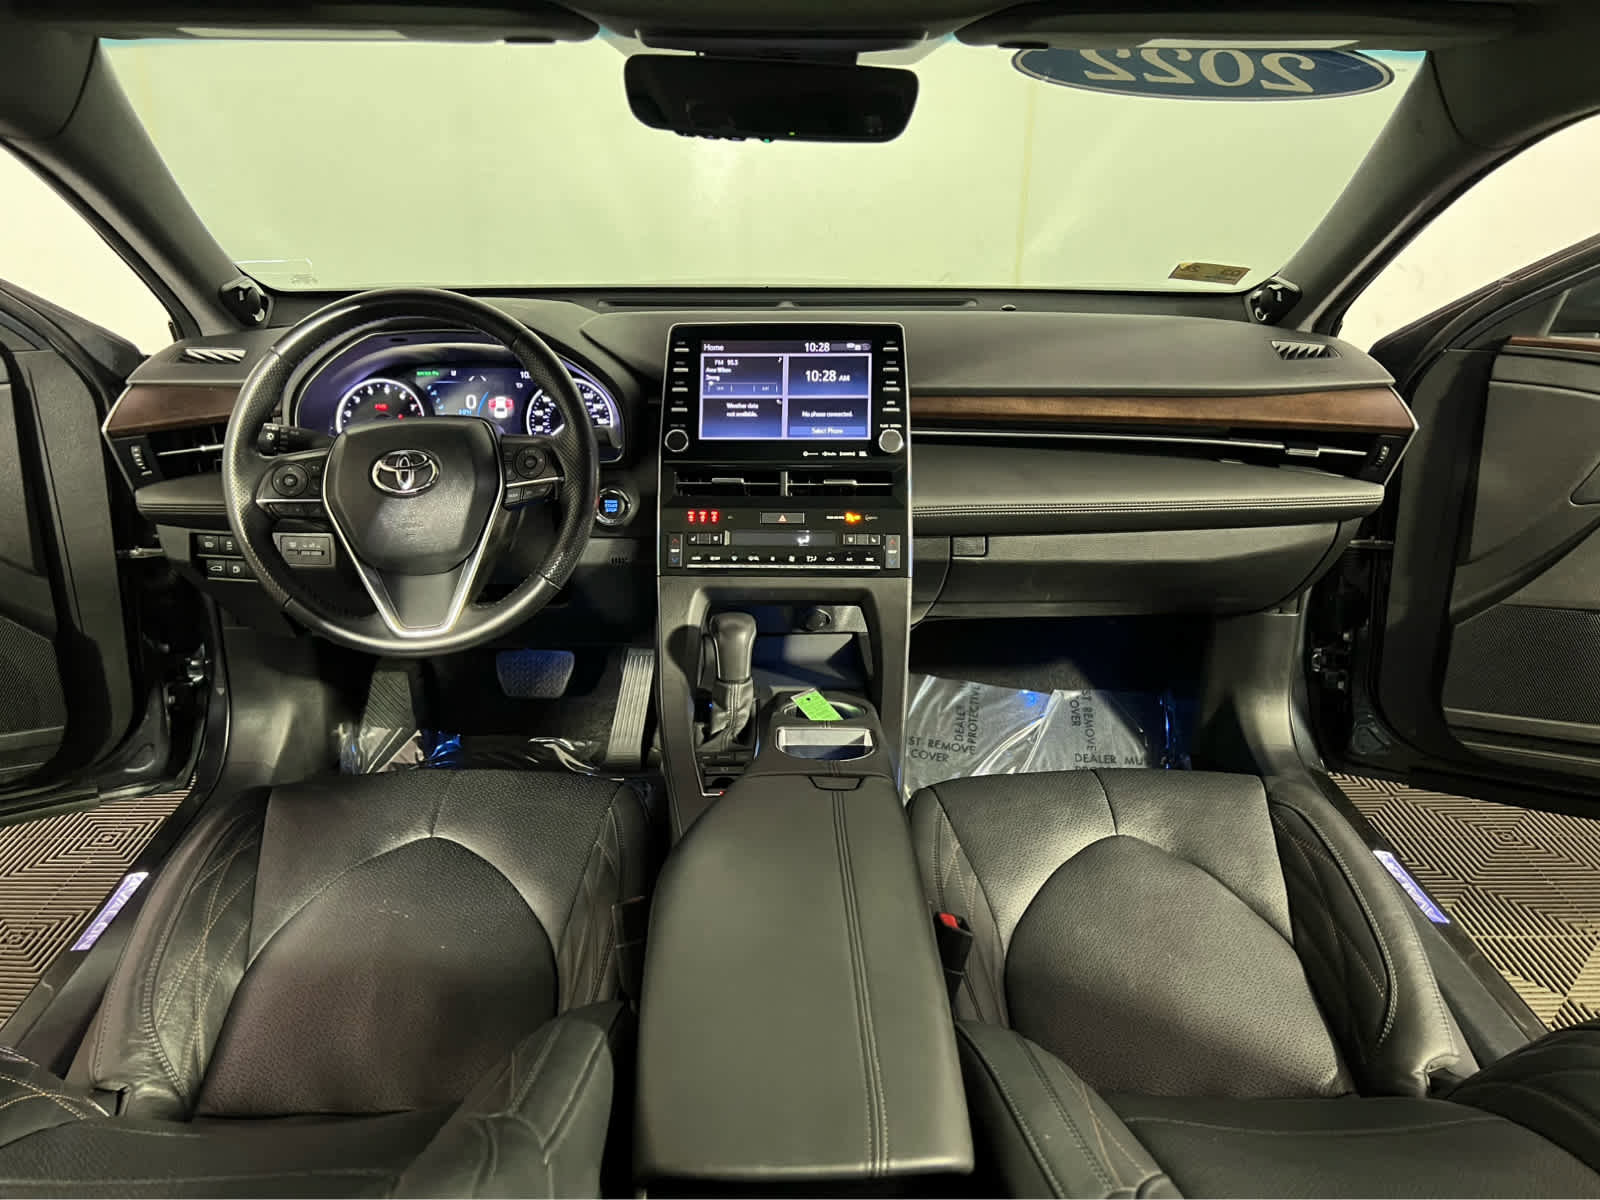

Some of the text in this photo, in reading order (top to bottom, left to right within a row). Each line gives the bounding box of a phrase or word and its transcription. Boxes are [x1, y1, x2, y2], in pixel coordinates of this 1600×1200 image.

[703, 343, 725, 351] Home
[804, 342, 831, 353] 10:28
[805, 370, 837, 382] 10:28
[465, 394, 477, 409] 0
[1069, 697, 1082, 727] OVER
[1083, 706, 1097, 751] REMOVE
[910, 748, 949, 762] COVER
[1074, 752, 1117, 765] DEALER
